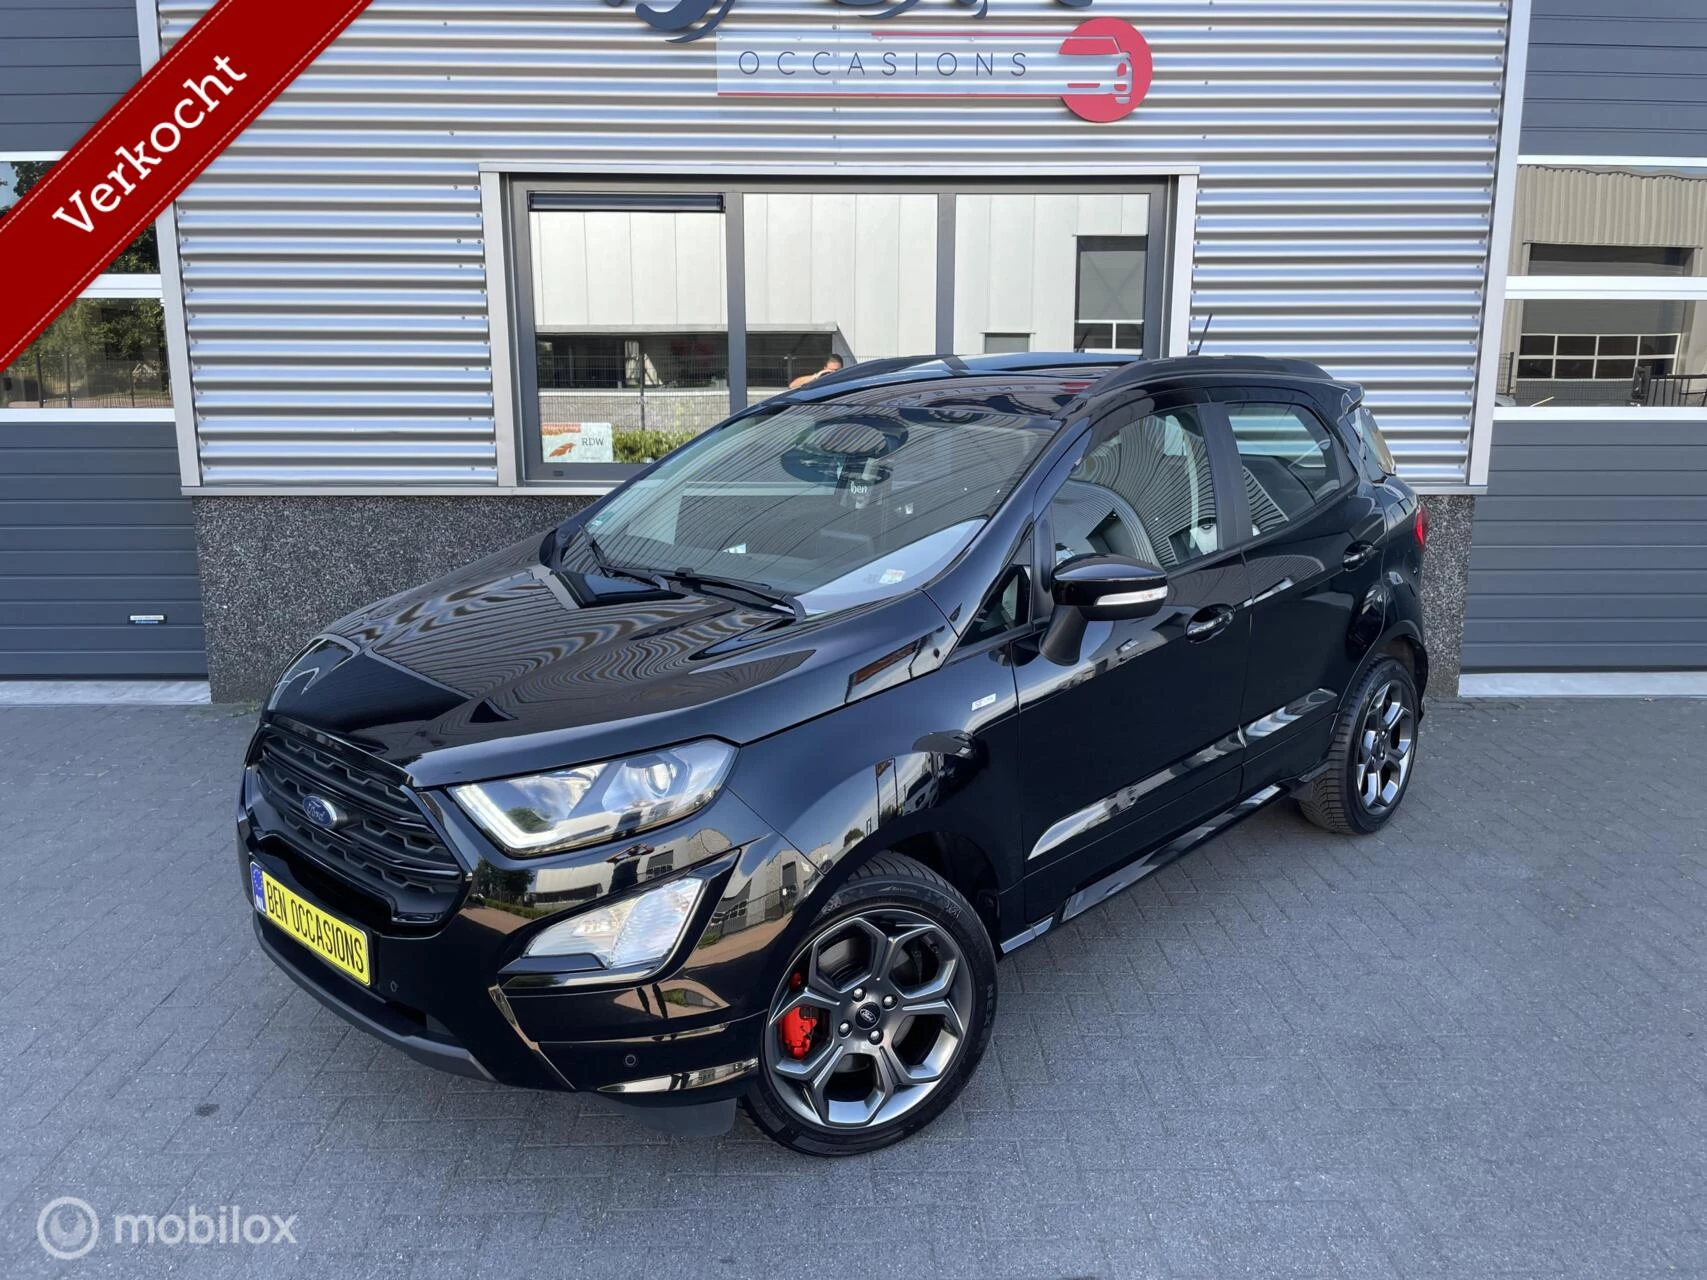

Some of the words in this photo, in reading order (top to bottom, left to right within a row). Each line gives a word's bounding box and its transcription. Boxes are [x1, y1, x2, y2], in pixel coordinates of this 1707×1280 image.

[738, 51, 1027, 77] OCCASIONS
[581, 437, 605, 446] RDW
[266, 880, 288, 925] BEN
[291, 899, 364, 973] OCCASIONS
